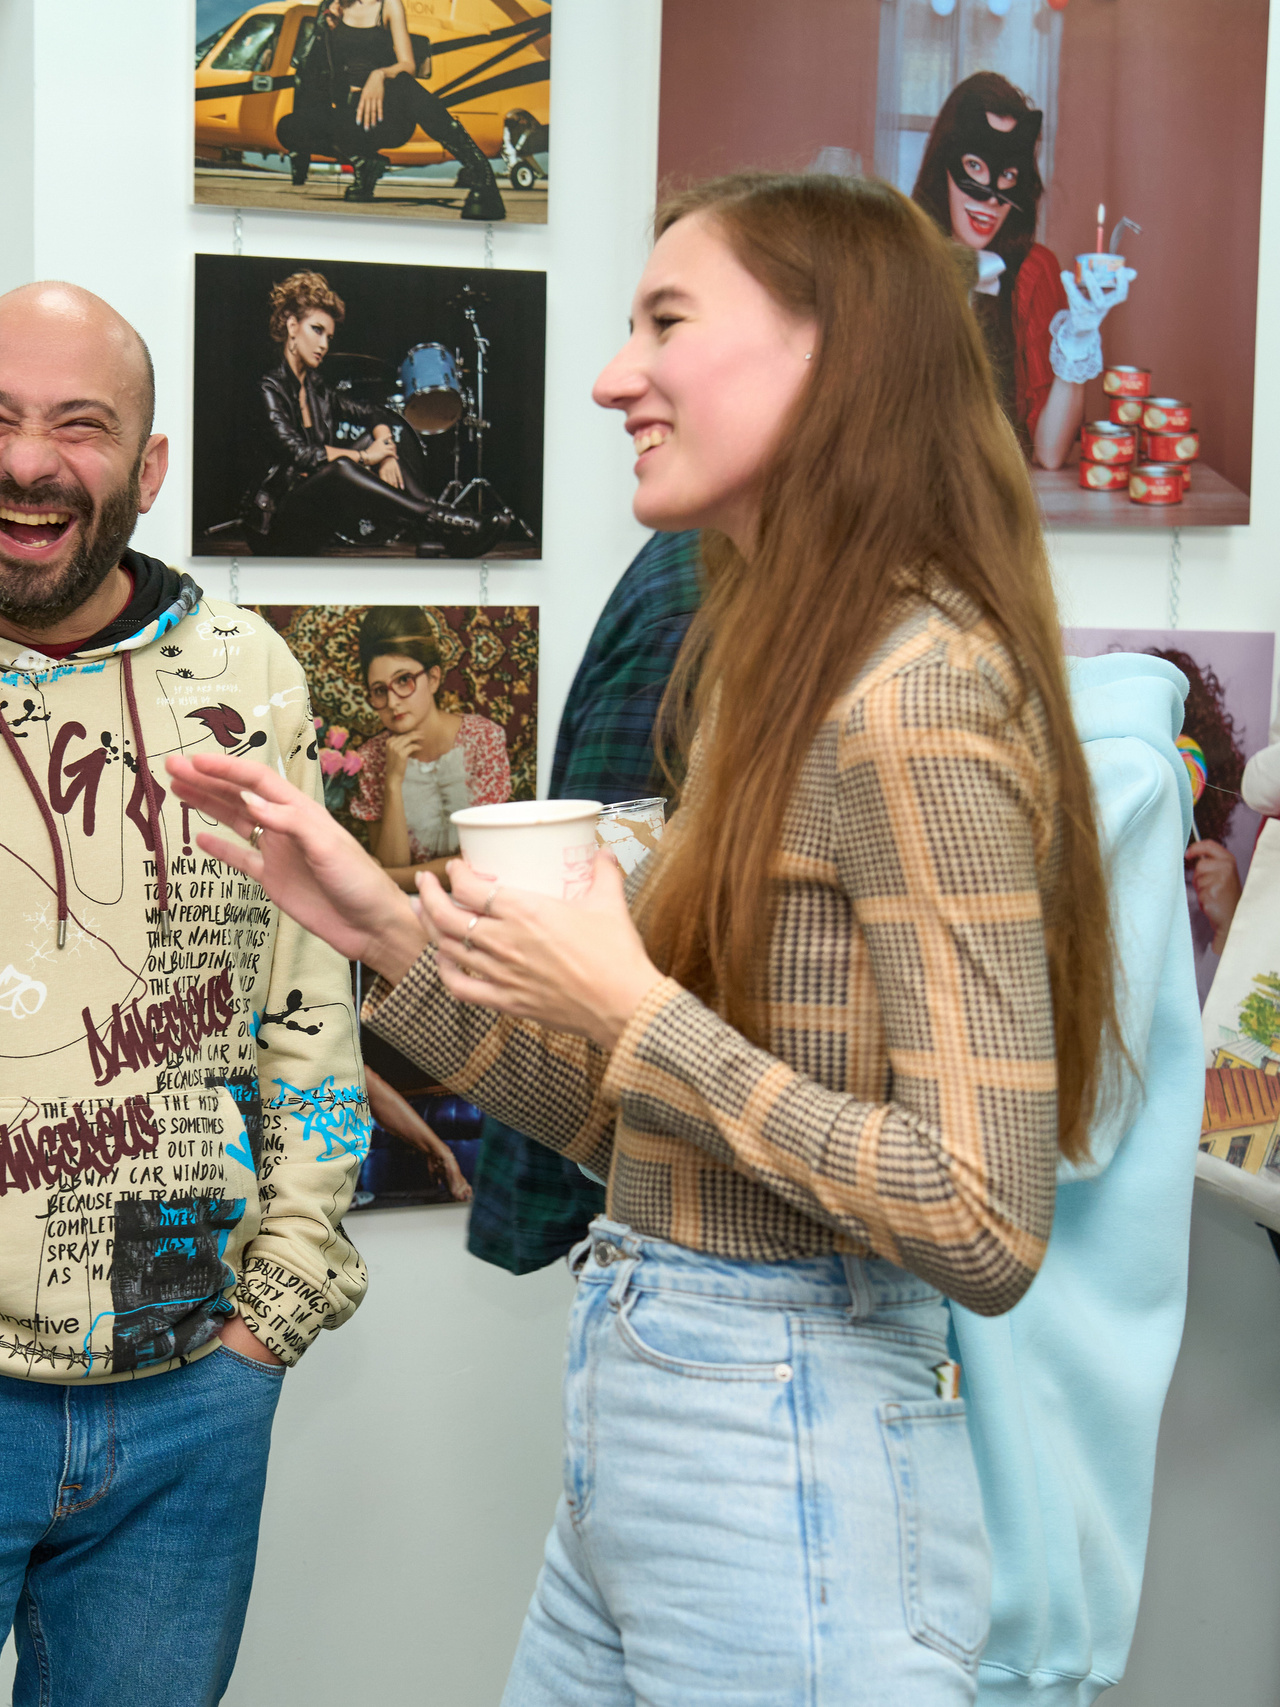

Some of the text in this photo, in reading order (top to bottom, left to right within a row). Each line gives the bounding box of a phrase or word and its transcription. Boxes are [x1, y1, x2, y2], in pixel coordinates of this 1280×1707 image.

[171, 856, 197, 876] NEW
[189, 881, 215, 899] OFF
[221, 879, 234, 899] IN
[145, 903, 178, 925] WHN
[180, 904, 221, 923] PEOPLE
[148, 950, 166, 973] ON
[149, 978, 171, 996] THE
[208, 1043, 231, 1065] CAR
[147, 1068, 205, 1096] BECAUSE
[40, 1101, 69, 1119] THE
[161, 1095, 190, 1112] THE
[198, 1095, 219, 1113] MID
[170, 1116, 225, 1135] SOMETIMES
[168, 1140, 196, 1159] OUT
[201, 1140, 214, 1158] OF
[218, 1141, 225, 1159] A
[129, 1165, 168, 1187] CAR
[35, 1191, 114, 1219] BECAUSE
[46, 1239, 100, 1264] SPRAY
[46, 1266, 72, 1288] AS
[290, 1304, 312, 1324] IN
